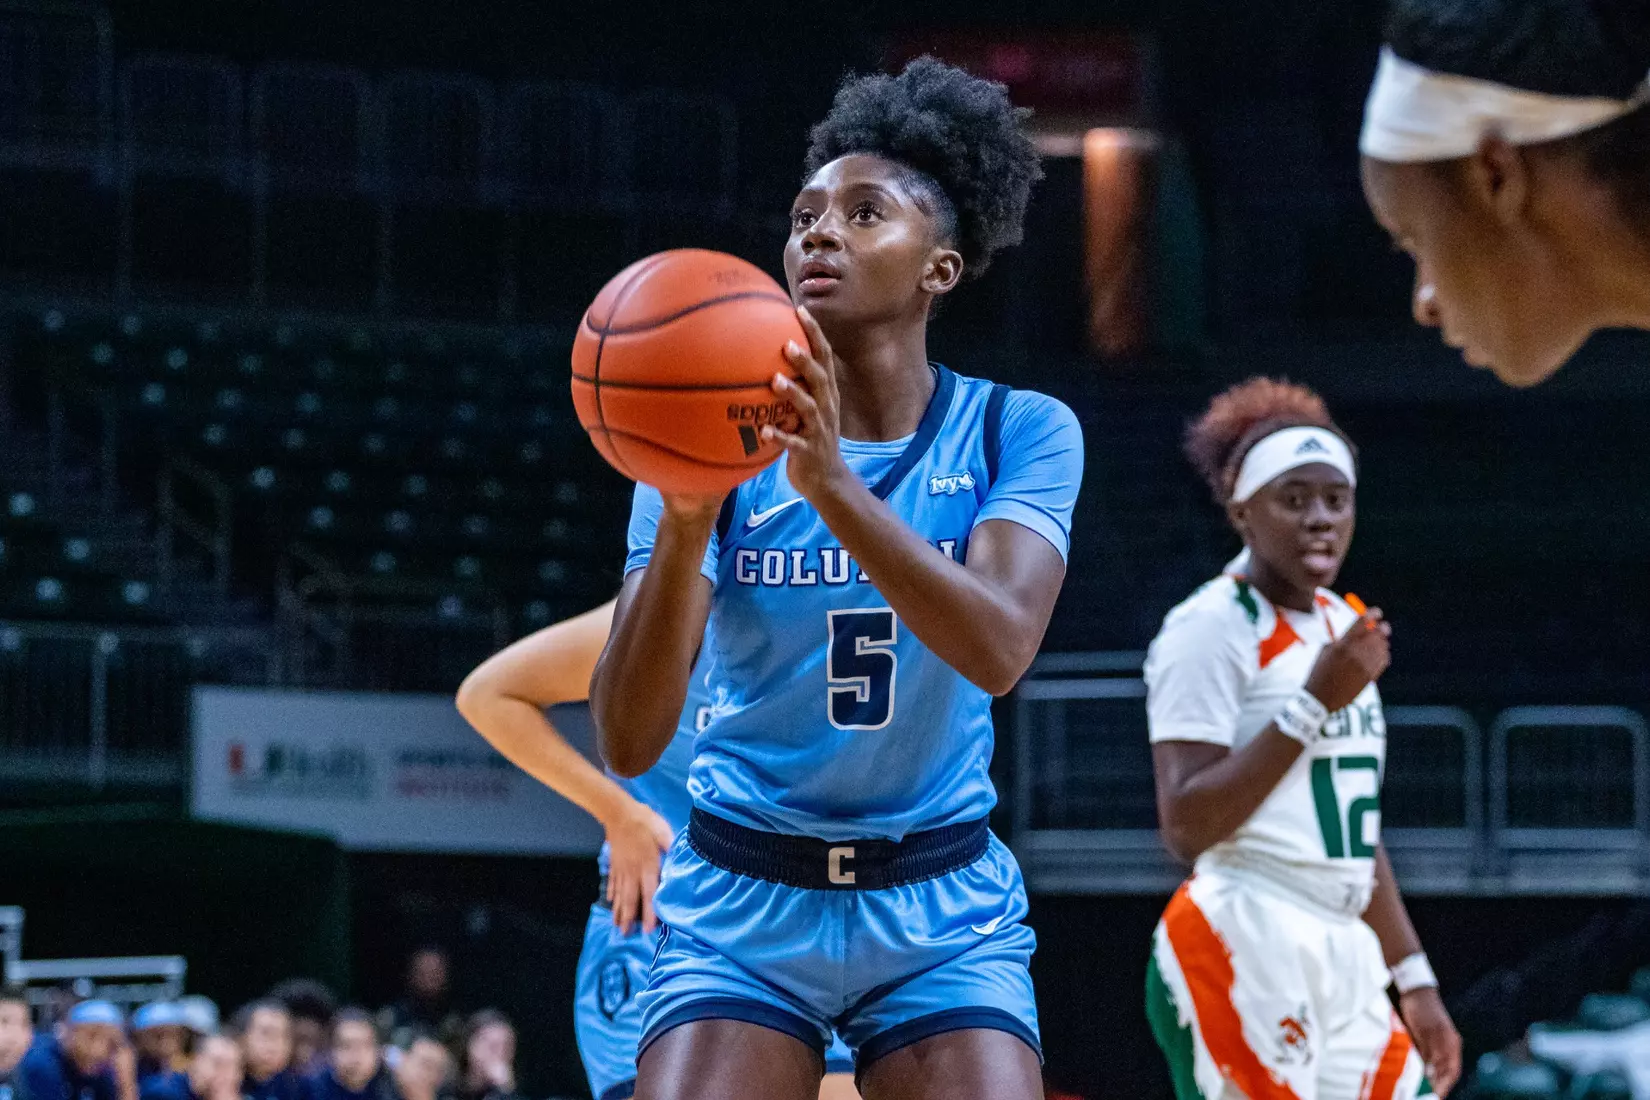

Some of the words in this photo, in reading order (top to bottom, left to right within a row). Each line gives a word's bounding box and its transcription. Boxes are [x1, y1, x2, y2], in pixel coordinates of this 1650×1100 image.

[735, 539, 957, 586] COLUI
[826, 607, 898, 731] 5
[1311, 756, 1380, 859] 12
[828, 846, 856, 884] C
